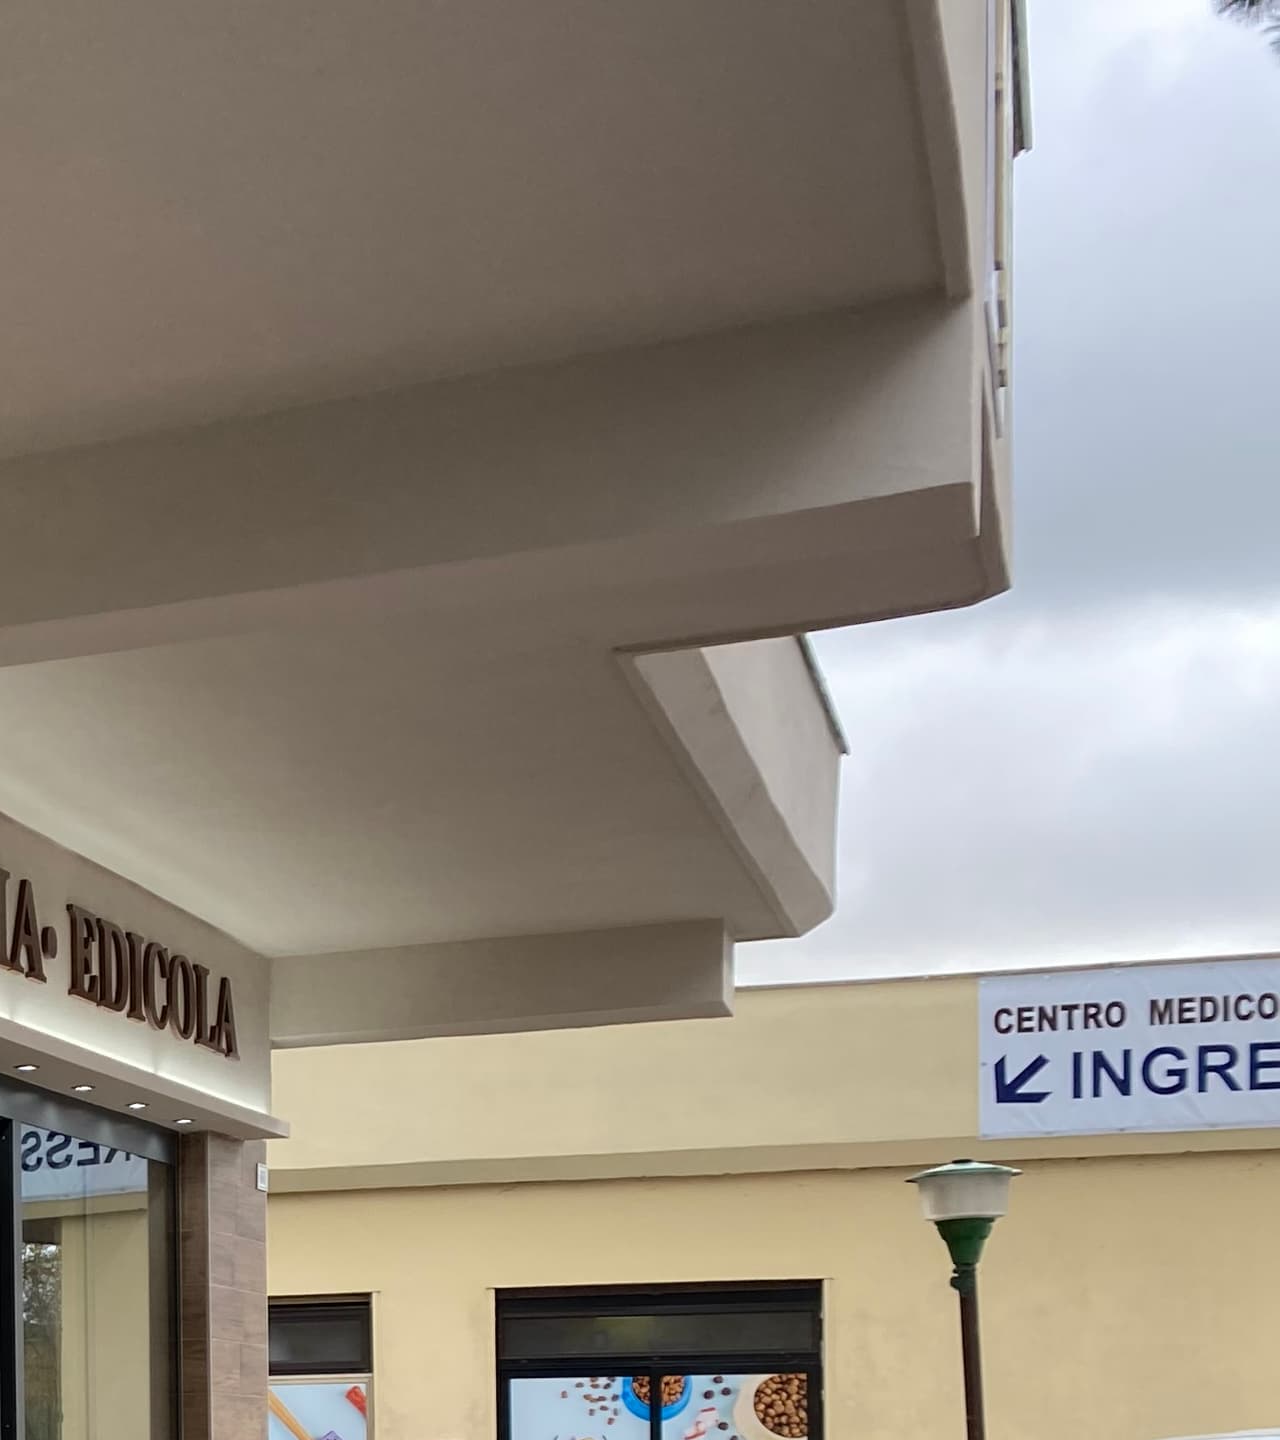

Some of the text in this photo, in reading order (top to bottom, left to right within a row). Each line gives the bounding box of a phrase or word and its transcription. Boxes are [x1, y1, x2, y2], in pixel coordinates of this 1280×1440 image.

[66, 903, 241, 1060] EDICOLA
[993, 992, 1279, 1035] CENTRO MEDICO
[1071, 1041, 1280, 1100] INGRE
